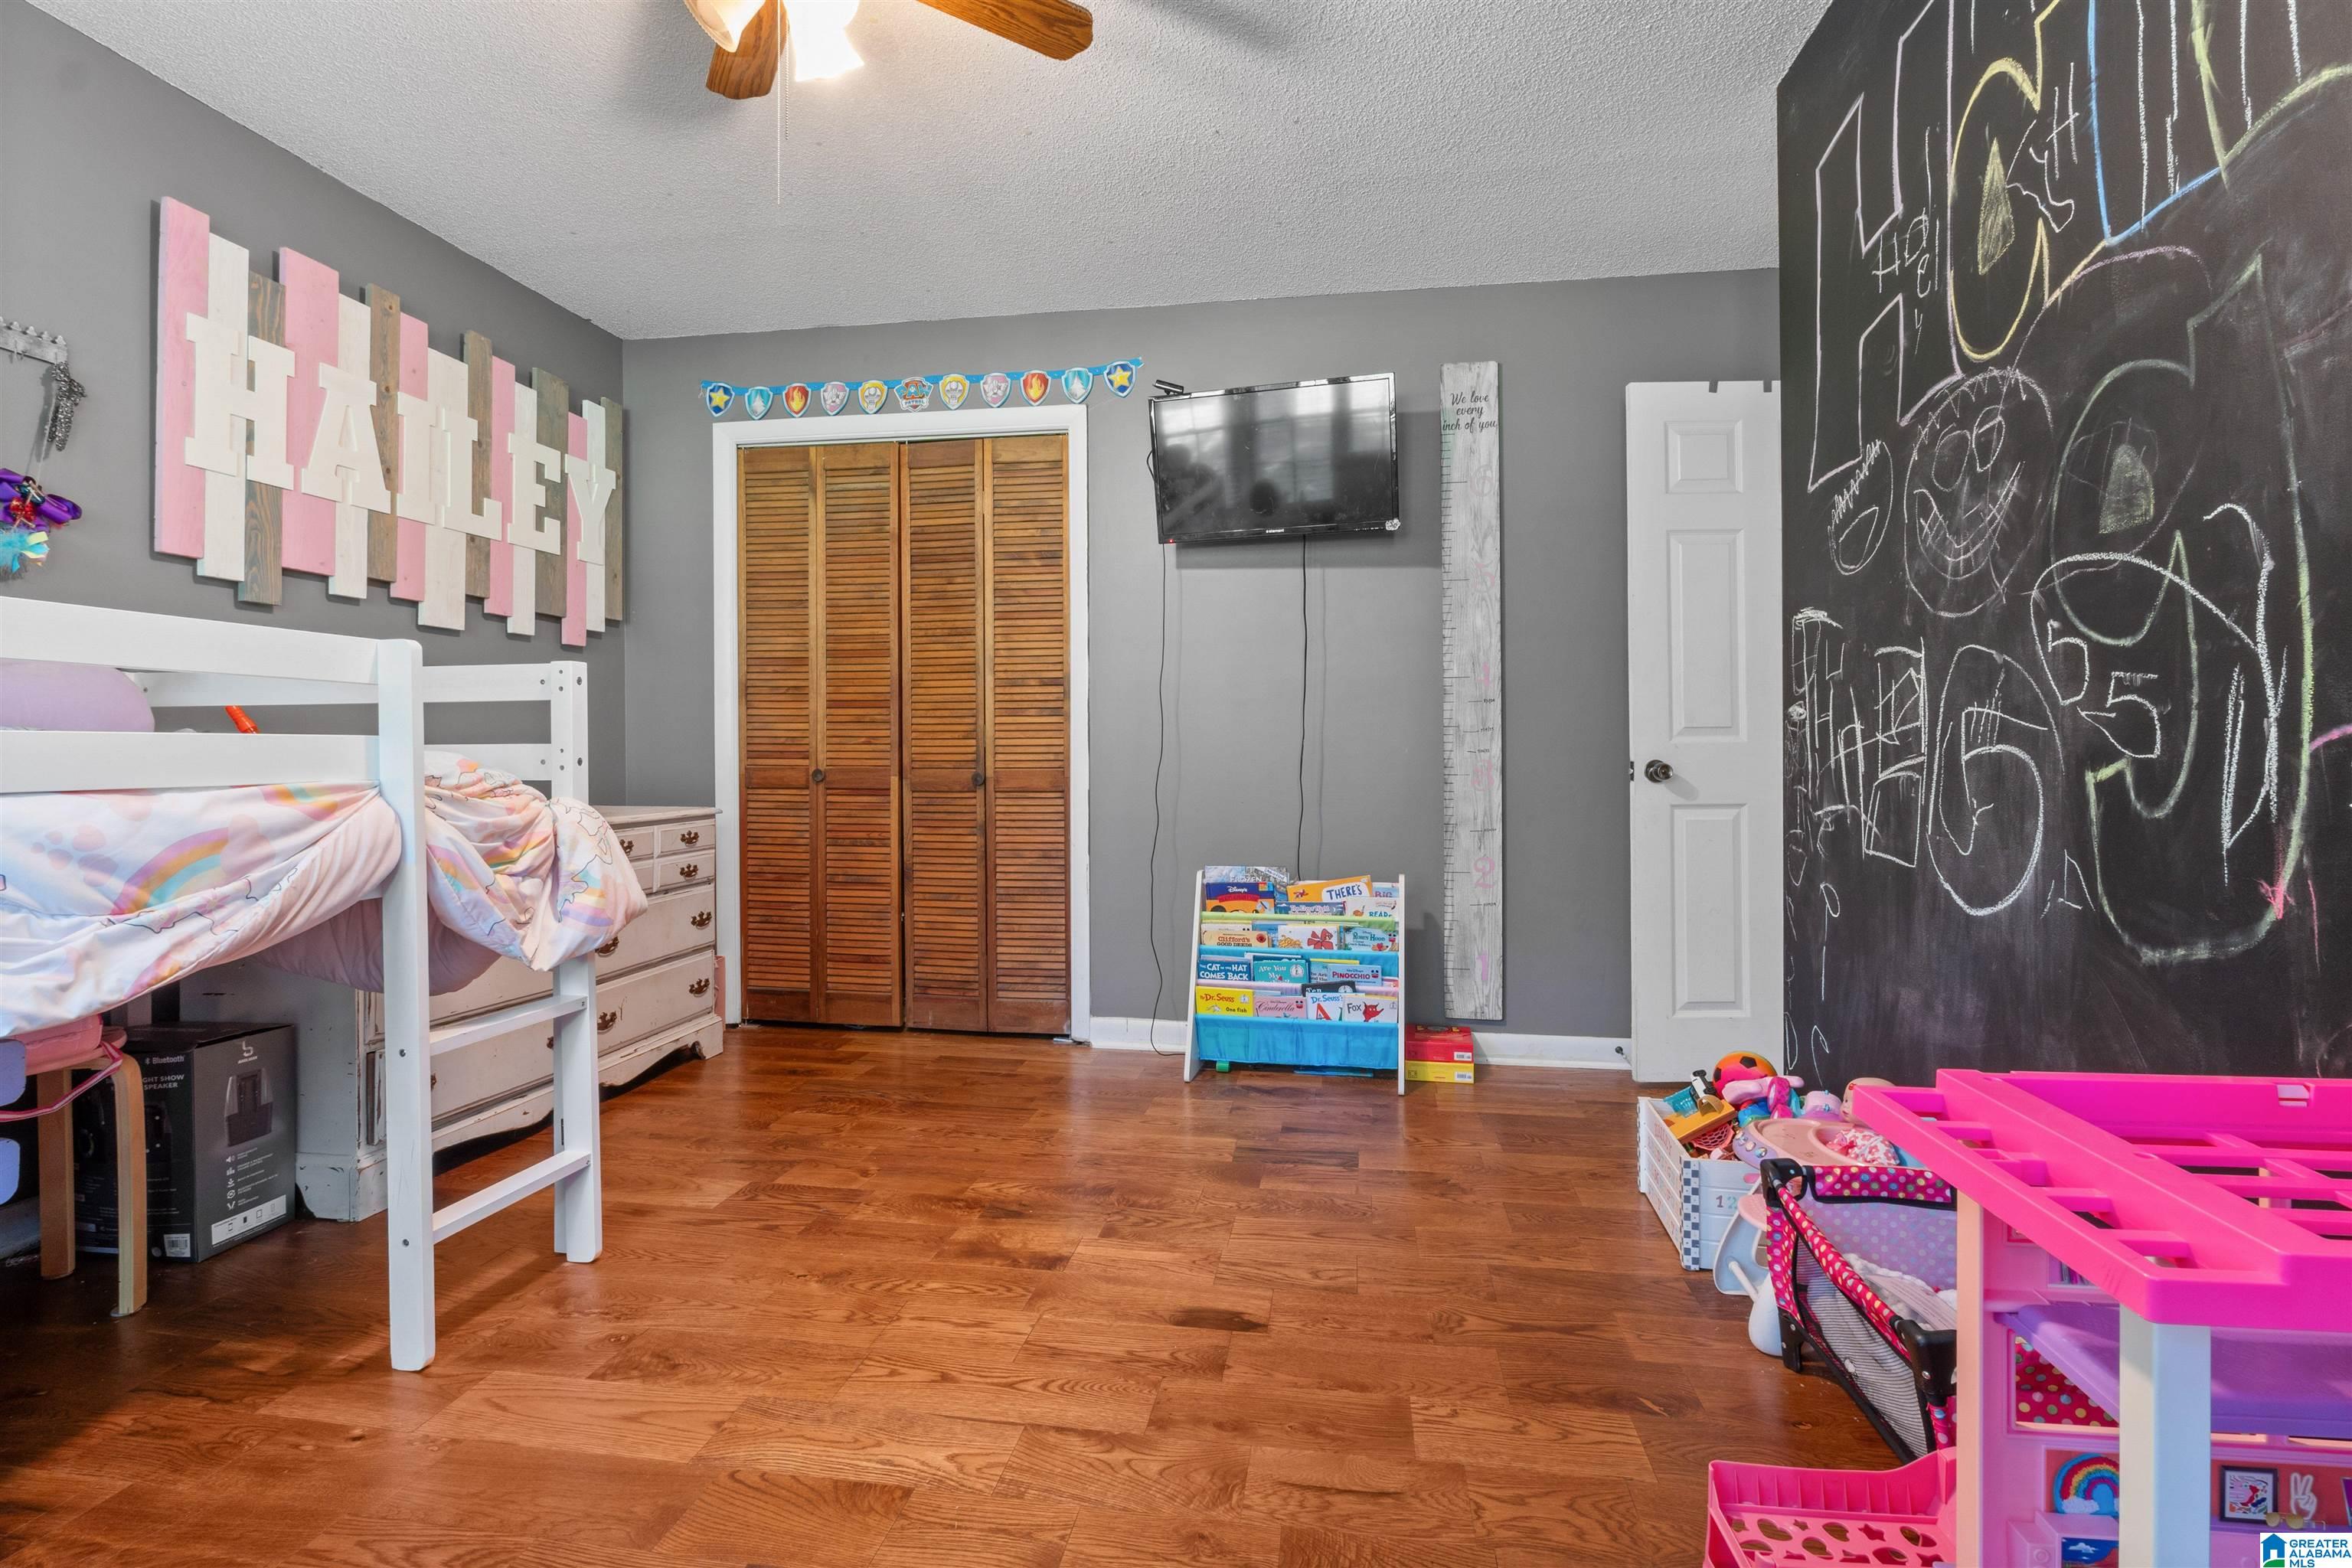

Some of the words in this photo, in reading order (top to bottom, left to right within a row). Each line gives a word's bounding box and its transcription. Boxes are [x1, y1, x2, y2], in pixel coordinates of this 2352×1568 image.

[1451, 392, 1467, 406] We
[1470, 390, 1489, 403] love
[1456, 407, 1483, 419] every
[1442, 418, 1462, 431] inch
[1465, 416, 1475, 434] of
[1478, 420, 1496, 433] you
[185, 312, 616, 566] HAILEY
[1473, 857, 1495, 889] 2
[1326, 884, 1362, 900] THERE'S
[1476, 951, 1489, 980] 1
[1200, 971, 1226, 979] COMES
[1227, 972, 1249, 980] BACK
[1332, 971, 1370, 979] PINOCCHIO
[1204, 993, 1216, 1001] Dr.
[1216, 993, 1235, 1002] Seuss
[1256, 1001, 1295, 1011] Cinderella
[152, 1056, 185, 1064] Bluetooth
[144, 1082, 178, 1090] SPEAKER
